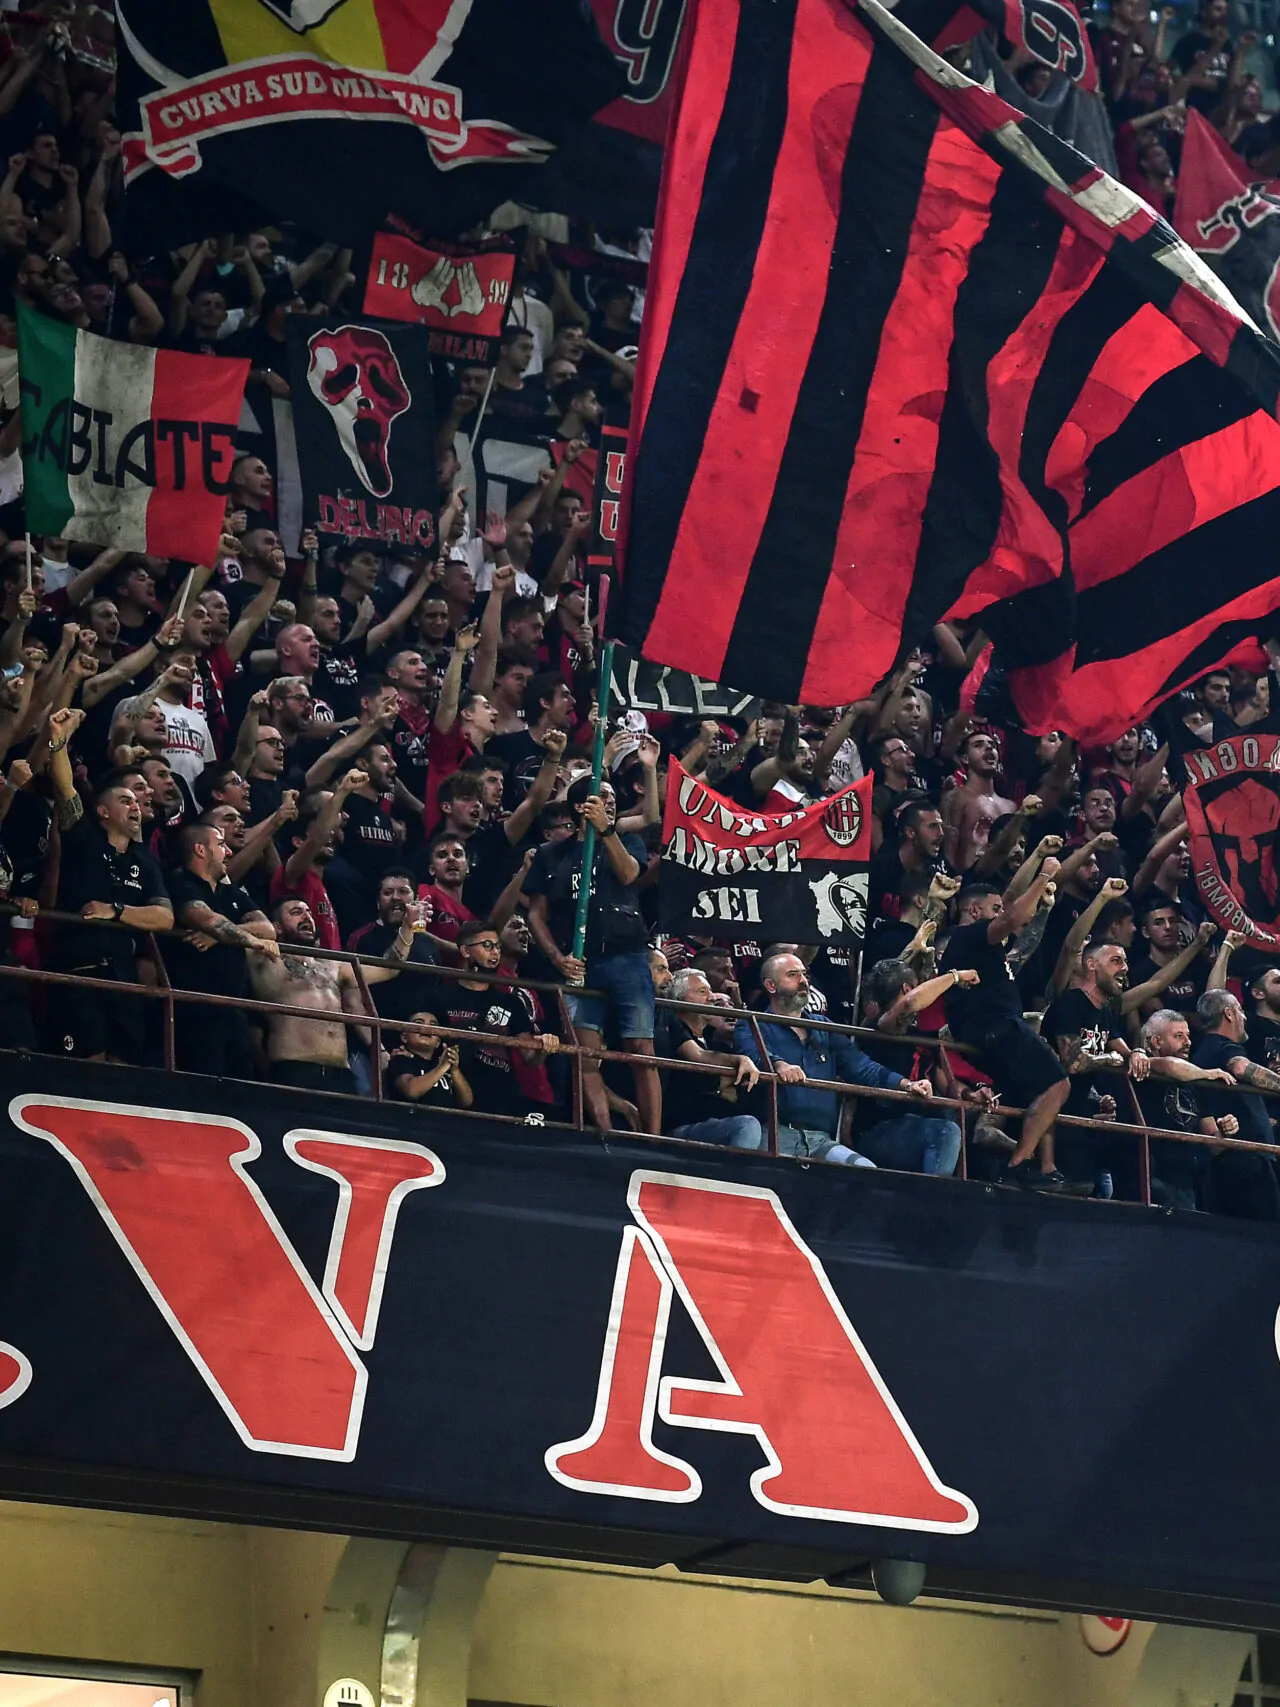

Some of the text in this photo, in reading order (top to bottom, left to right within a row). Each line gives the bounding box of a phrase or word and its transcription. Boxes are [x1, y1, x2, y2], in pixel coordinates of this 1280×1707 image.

[159, 80, 264, 128] CURVA
[268, 71, 328, 99] SUD
[359, 825, 396, 842] ULTRA
[832, 831, 853, 841] 1899
[691, 886, 762, 923] SEI
[0, 1092, 980, 1536] VA
